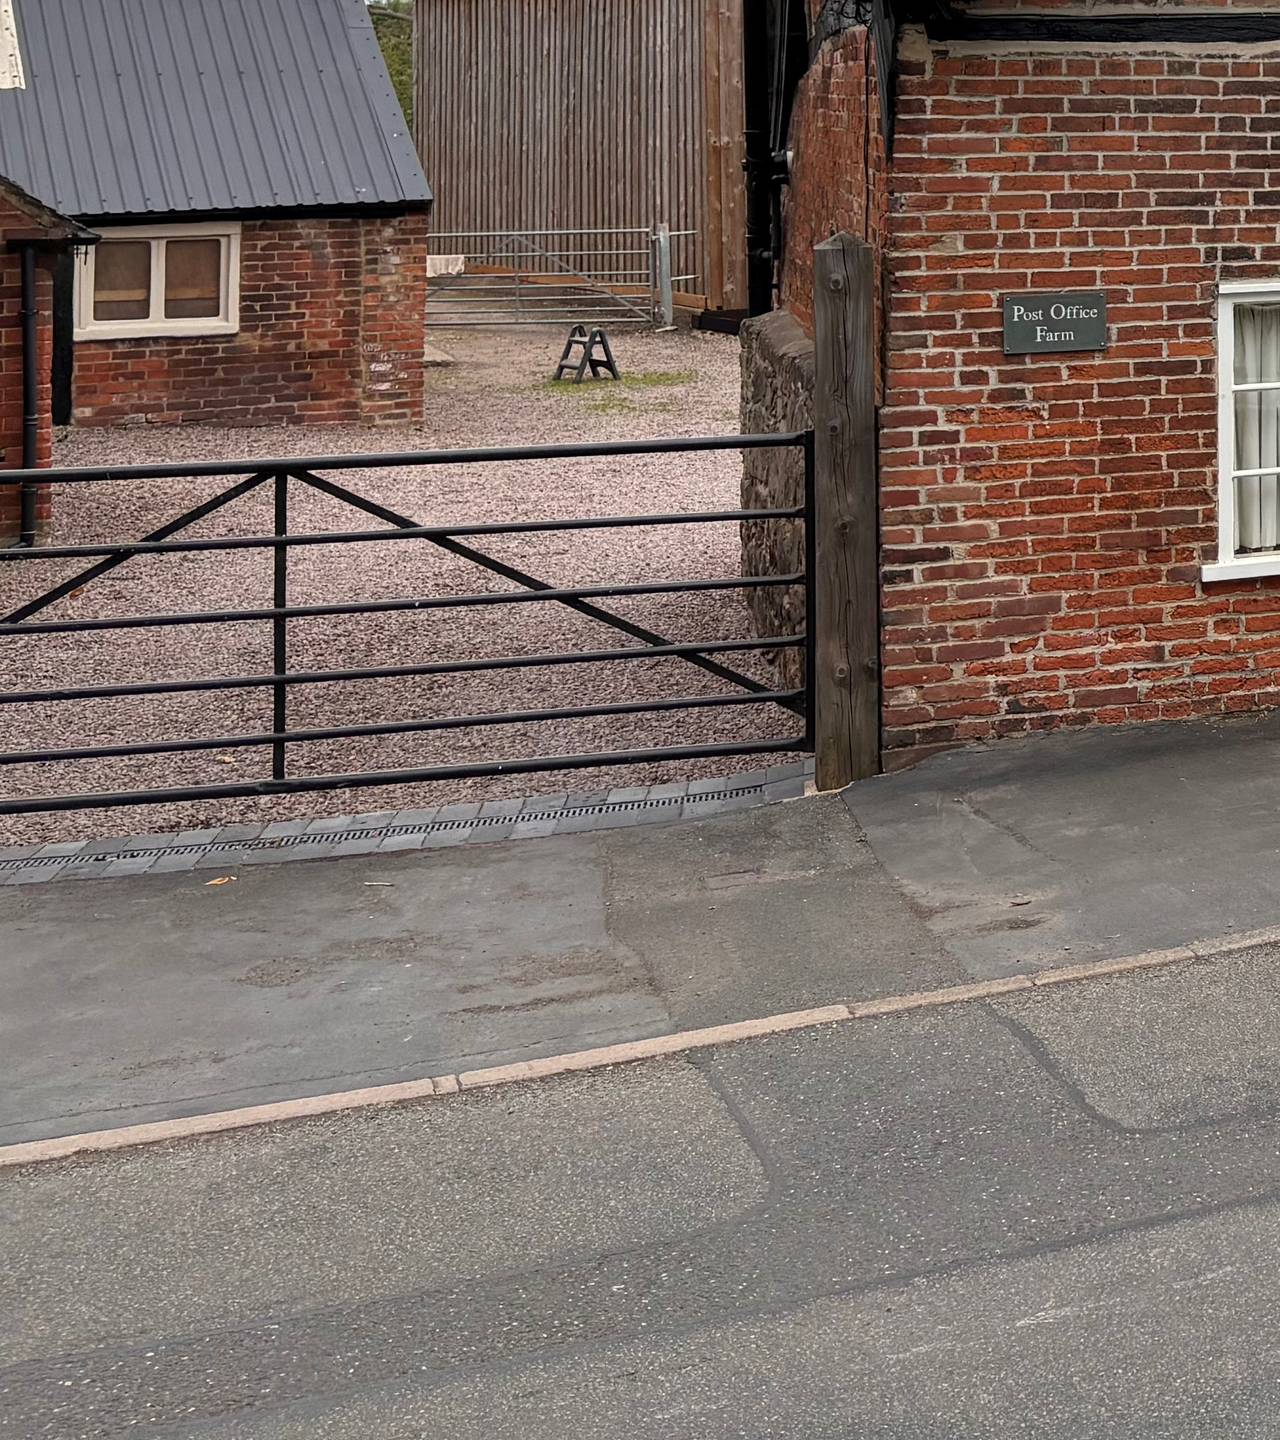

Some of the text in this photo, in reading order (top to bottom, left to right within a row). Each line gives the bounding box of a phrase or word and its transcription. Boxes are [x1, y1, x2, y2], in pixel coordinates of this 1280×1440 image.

[1012, 303, 1098, 322] Post Office
[1035, 326, 1075, 342] Farm
